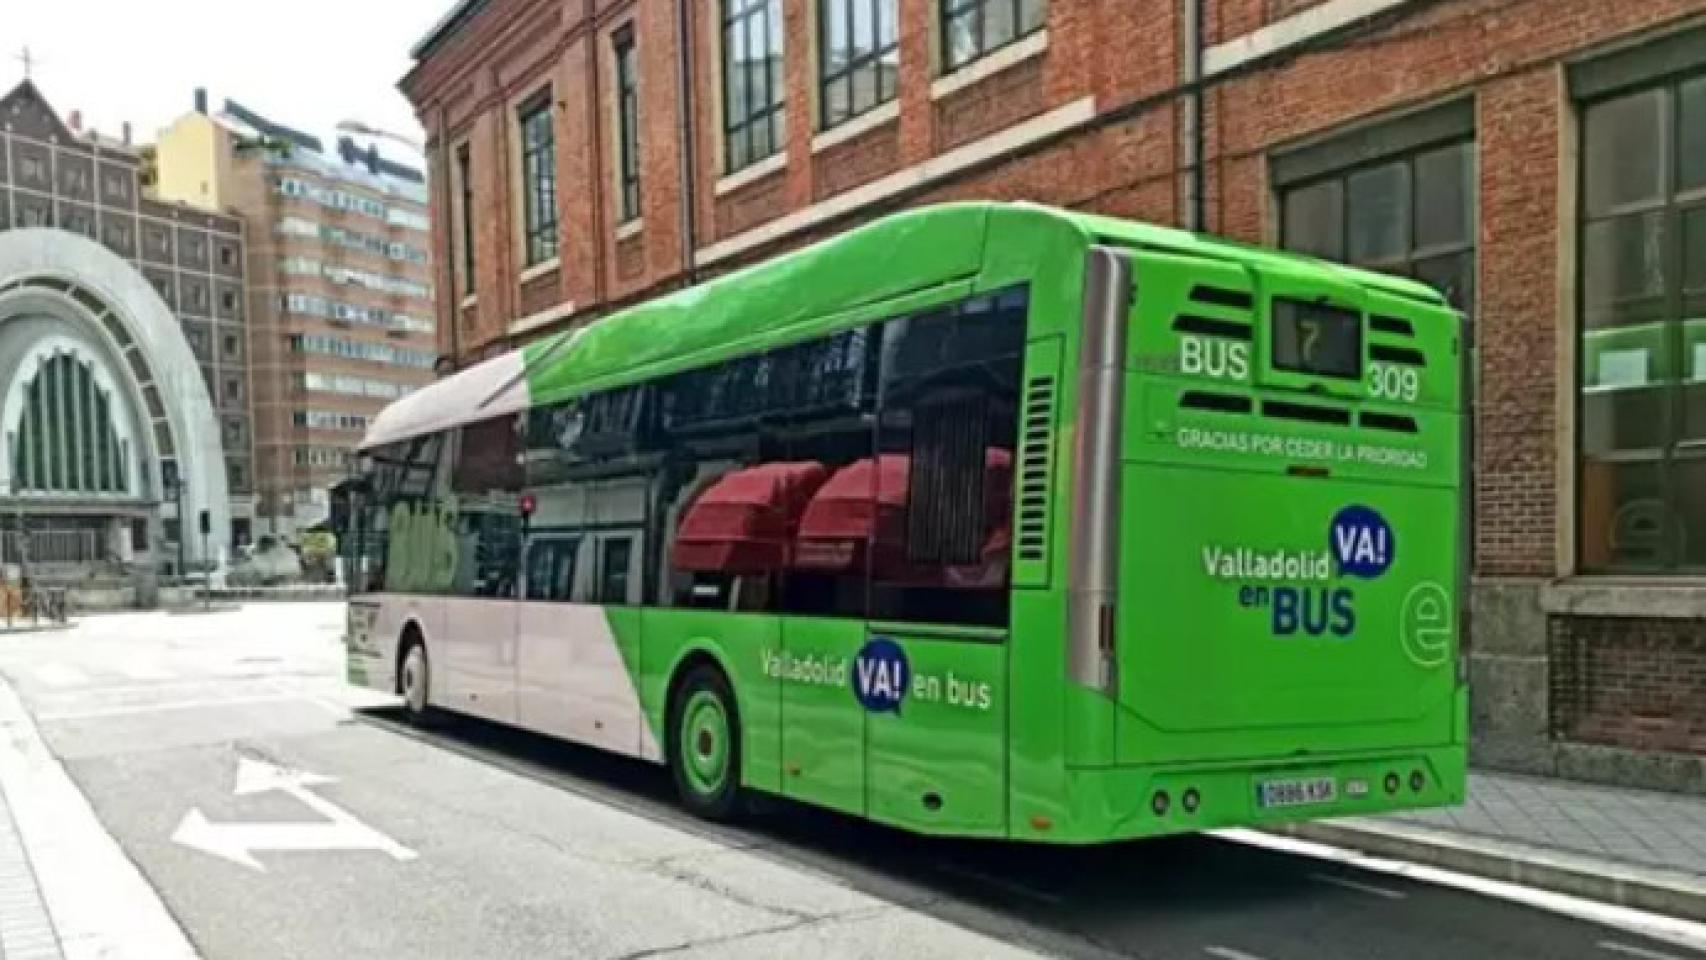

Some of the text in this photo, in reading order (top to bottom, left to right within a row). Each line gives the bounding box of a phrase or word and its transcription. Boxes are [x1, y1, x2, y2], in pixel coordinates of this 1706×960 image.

[1180, 335, 1249, 380] BUS
[1367, 364, 1419, 402] 309
[1177, 427, 1247, 452] GRACIAS
[1202, 524, 1386, 580] Valladolid VA!
[1237, 584, 1355, 636] en BUS
[760, 648, 991, 709] Valladolid VA! en bus
